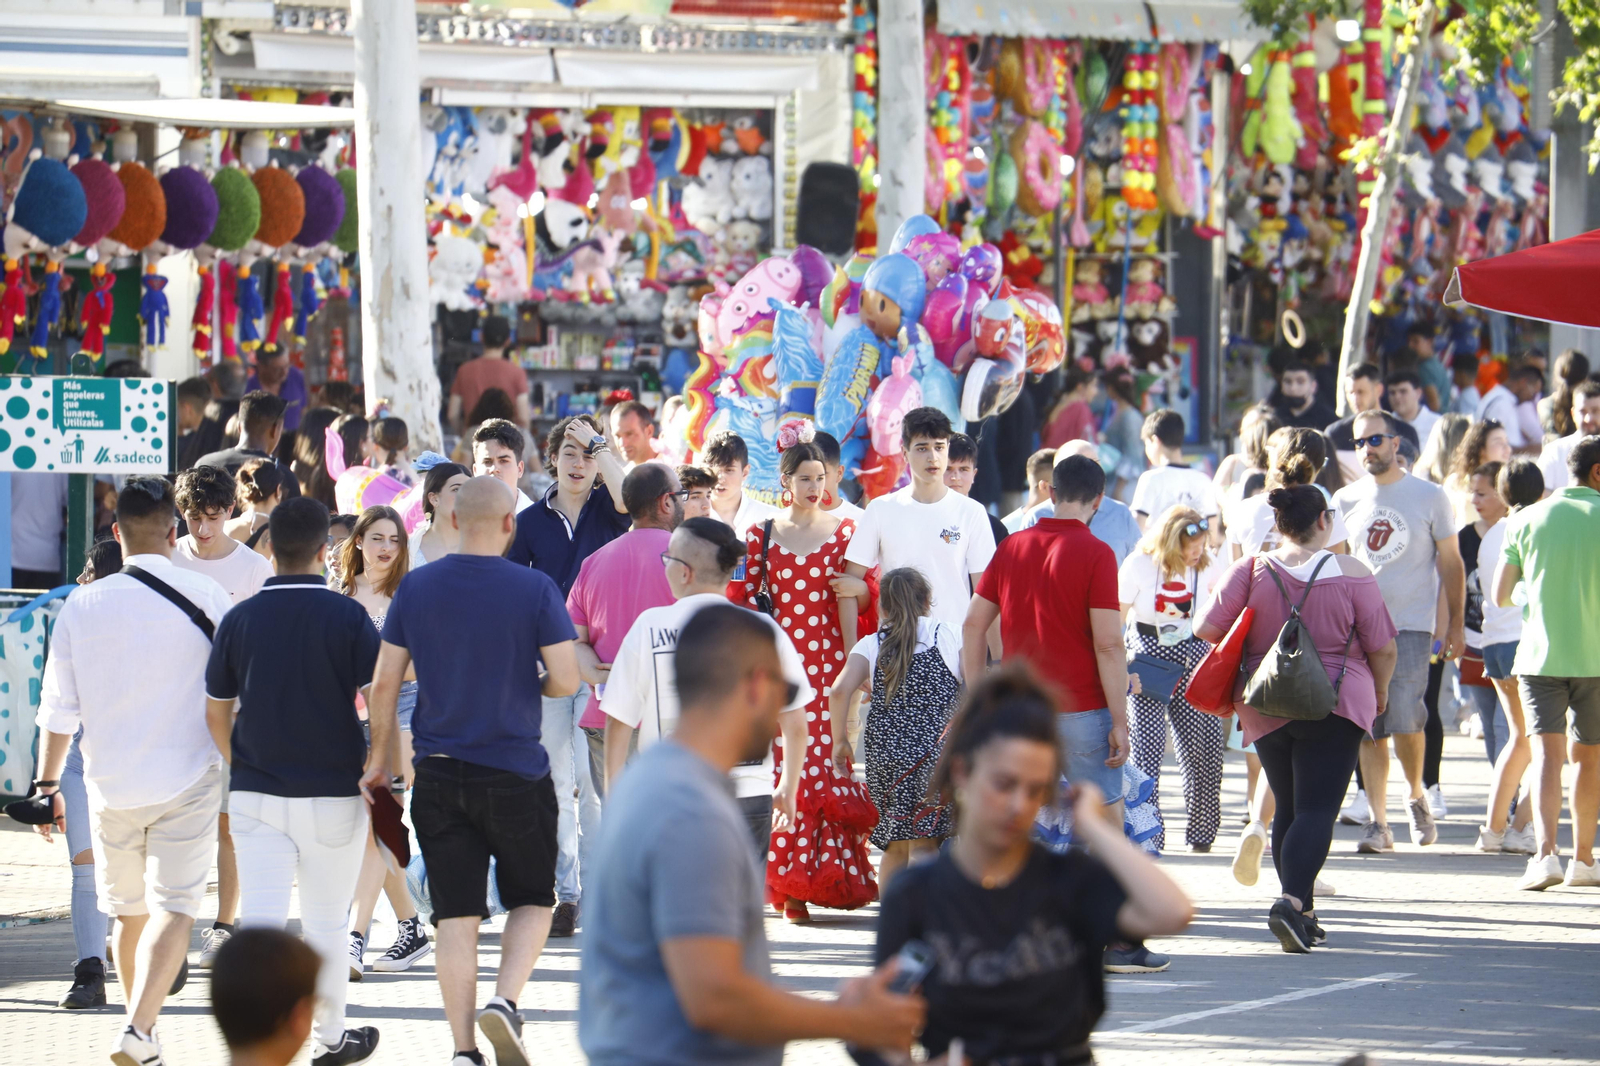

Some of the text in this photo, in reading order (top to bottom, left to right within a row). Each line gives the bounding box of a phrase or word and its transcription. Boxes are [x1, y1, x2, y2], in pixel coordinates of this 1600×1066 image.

[63, 381, 81, 390] Más
[63, 390, 105, 400] papeleras
[63, 400, 79, 409] que
[63, 409, 98, 418] lunares.
[63, 418, 104, 427] Utilízalas
[114, 451, 162, 464] sadeco
[1388, 511, 1406, 532] STONES
[650, 627, 678, 649] LAW
